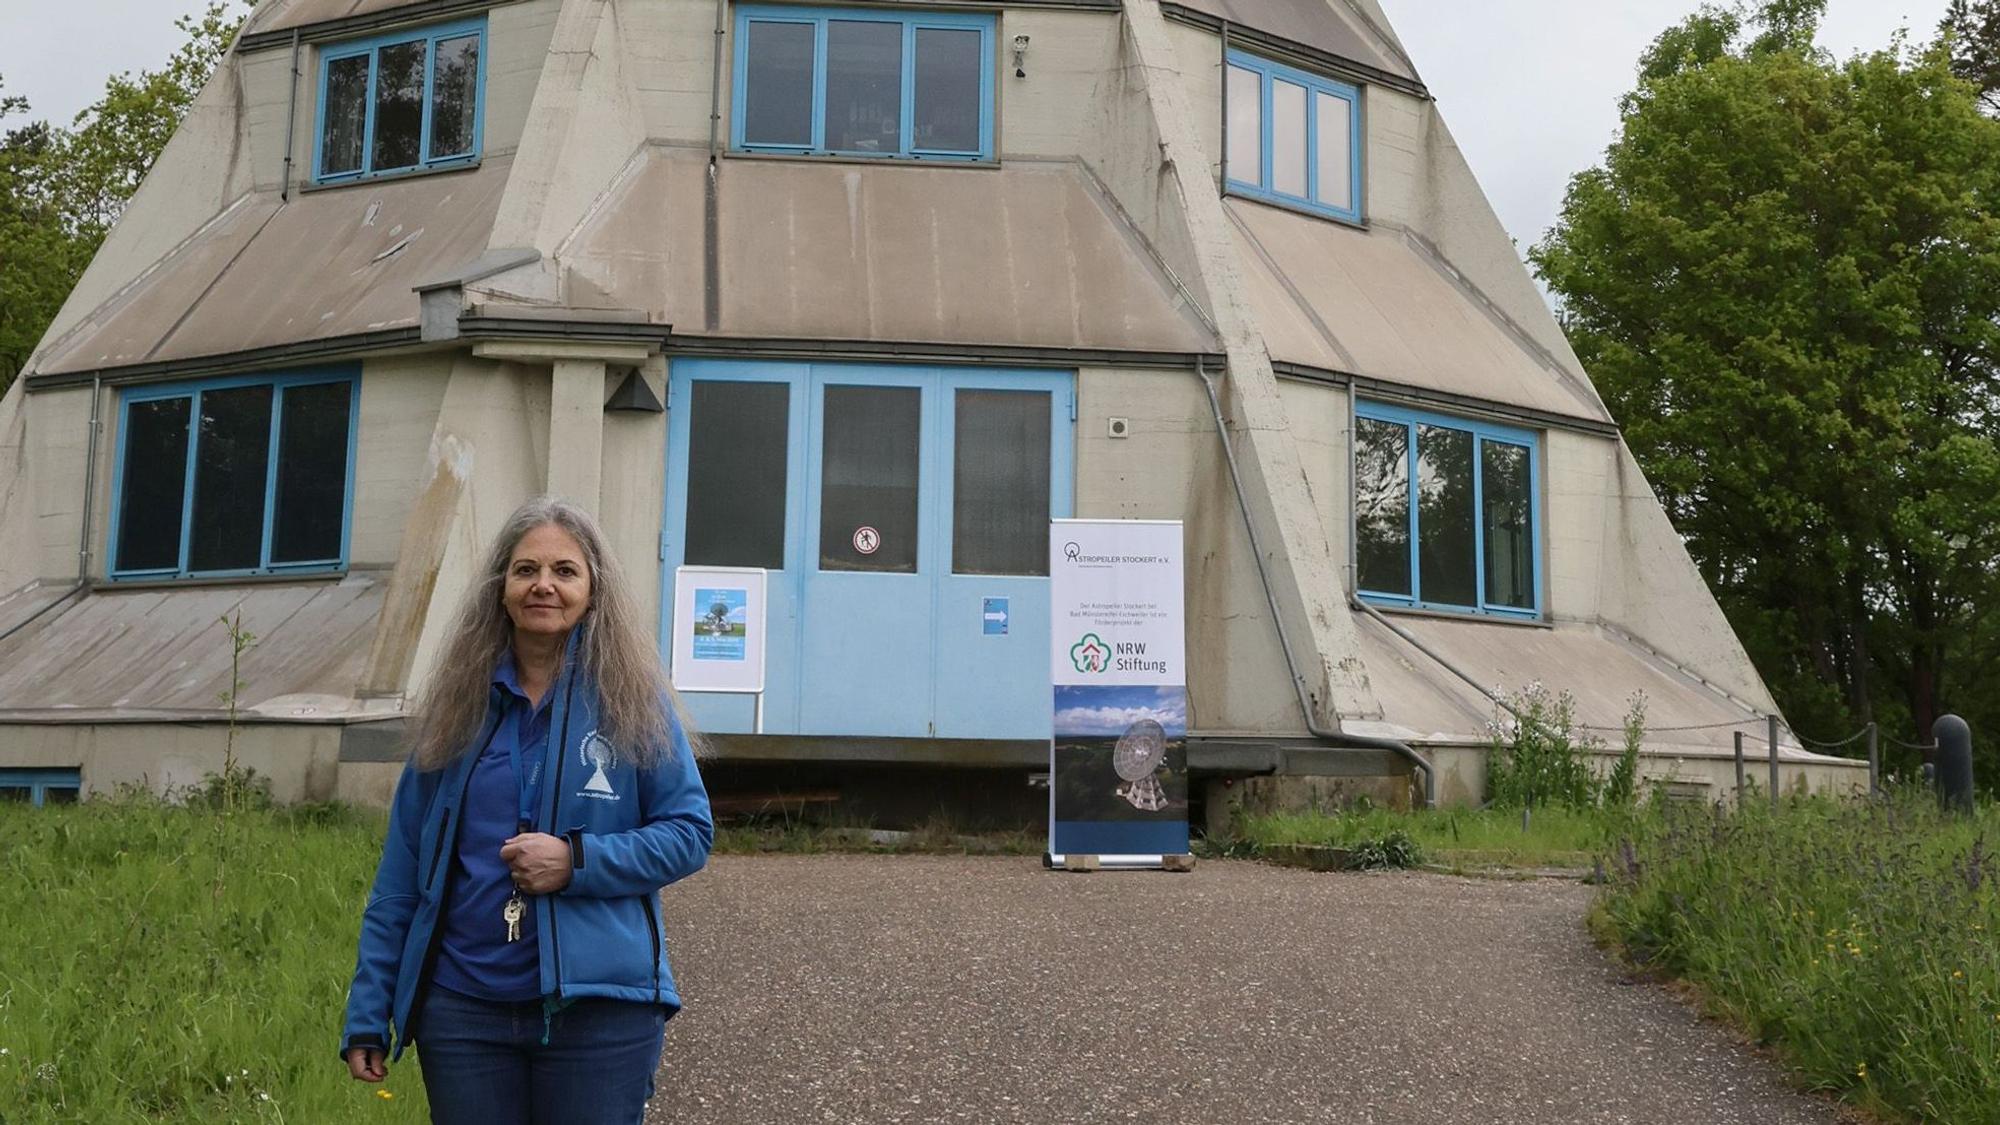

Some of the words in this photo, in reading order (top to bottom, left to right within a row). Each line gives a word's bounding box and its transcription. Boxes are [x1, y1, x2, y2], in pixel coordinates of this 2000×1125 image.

[1067, 549, 1120, 563] ASTROPEILER
[1116, 643, 1146, 655] NRW
[1116, 658, 1167, 673] Stiftung
